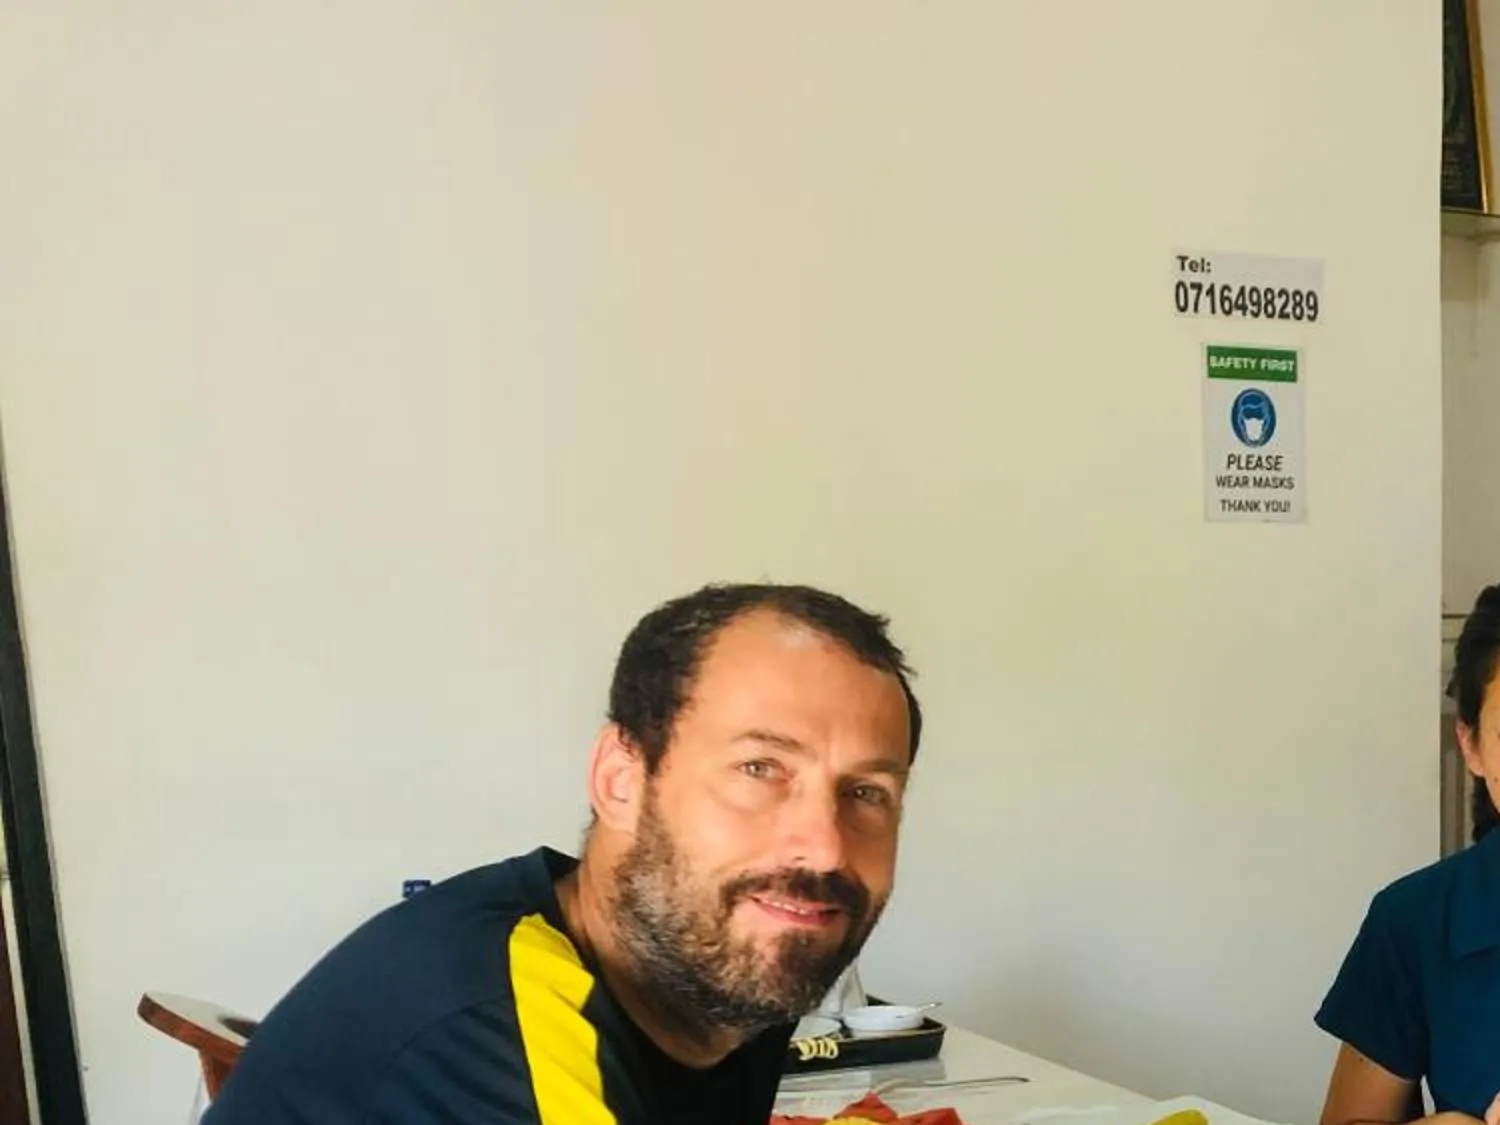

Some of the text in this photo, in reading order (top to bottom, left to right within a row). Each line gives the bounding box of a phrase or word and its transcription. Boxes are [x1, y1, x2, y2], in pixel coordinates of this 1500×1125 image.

[1175, 255, 1212, 274] Tel:
[1175, 280, 1319, 322] 0716498289
[1209, 355, 1295, 372] SAFETY FIRST
[1226, 453, 1284, 471] PLEASE
[1215, 475, 1295, 490] WEAR MASKS
[1219, 499, 1291, 512] THANK YOU!
